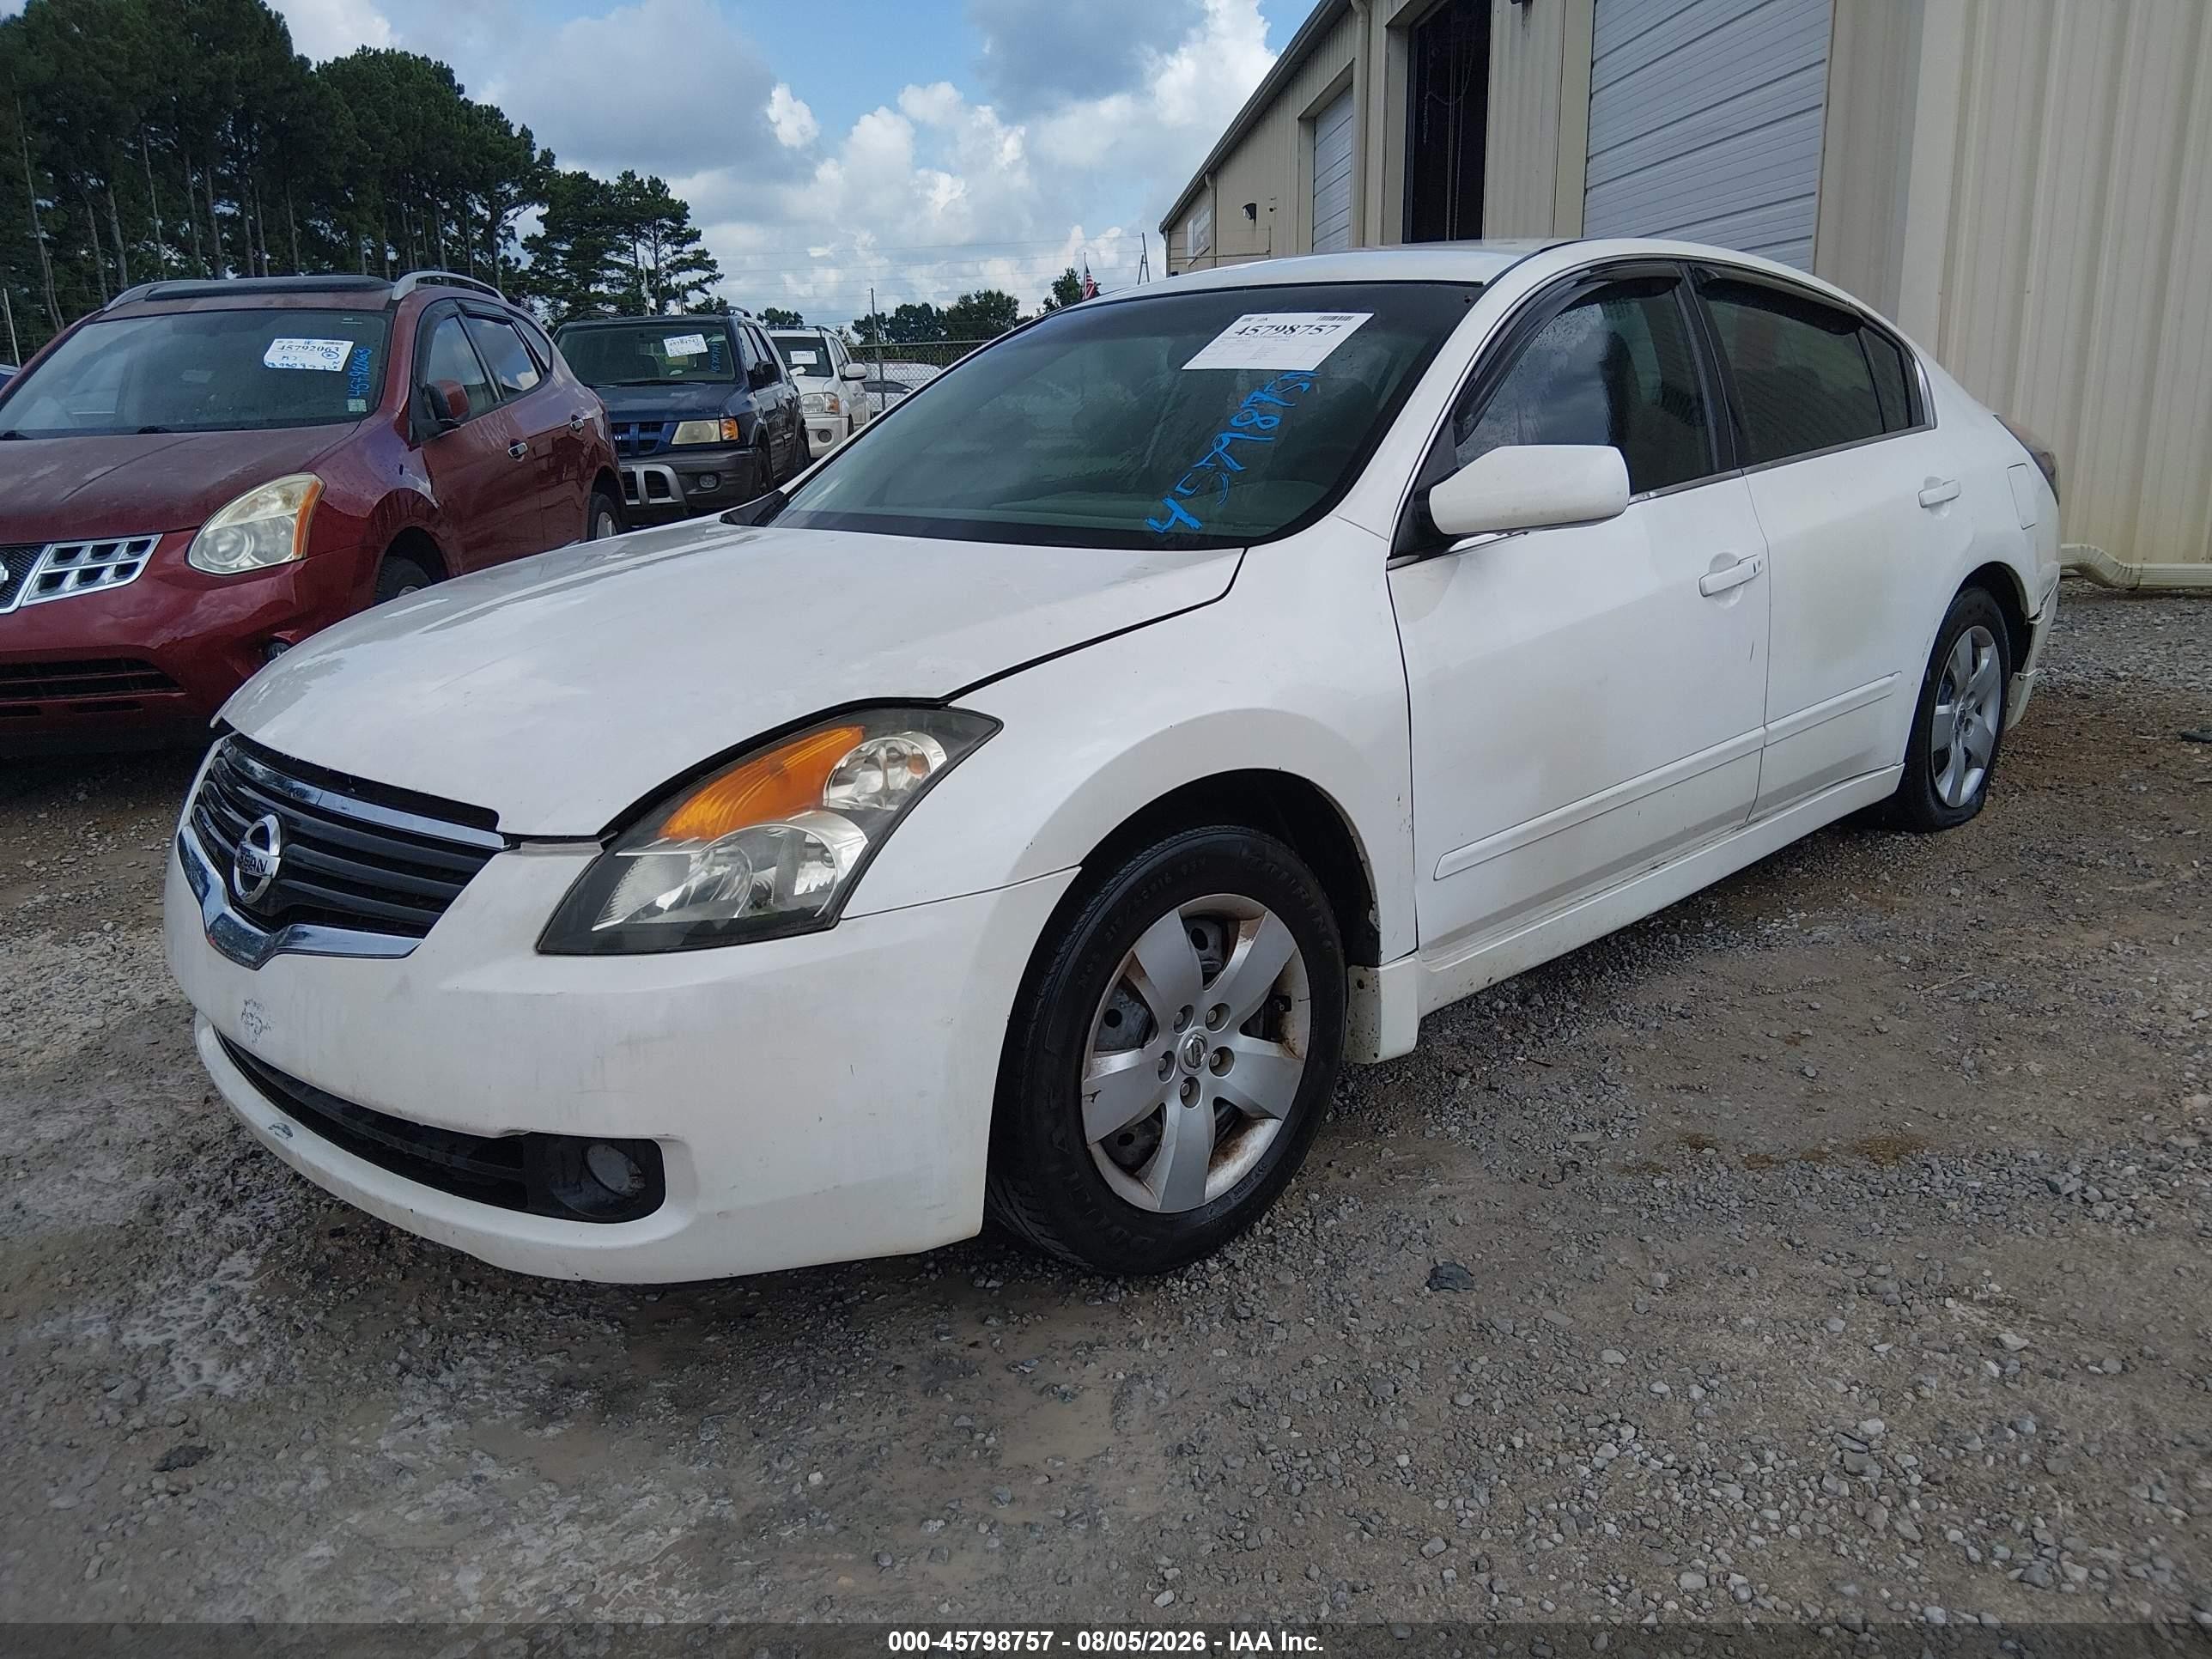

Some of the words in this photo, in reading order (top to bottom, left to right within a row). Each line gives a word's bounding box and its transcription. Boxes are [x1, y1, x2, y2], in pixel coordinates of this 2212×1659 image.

[1234, 325, 1341, 336] 45798757
[277, 344, 340, 353] 45792063
[349, 349, 373, 397] 45792063
